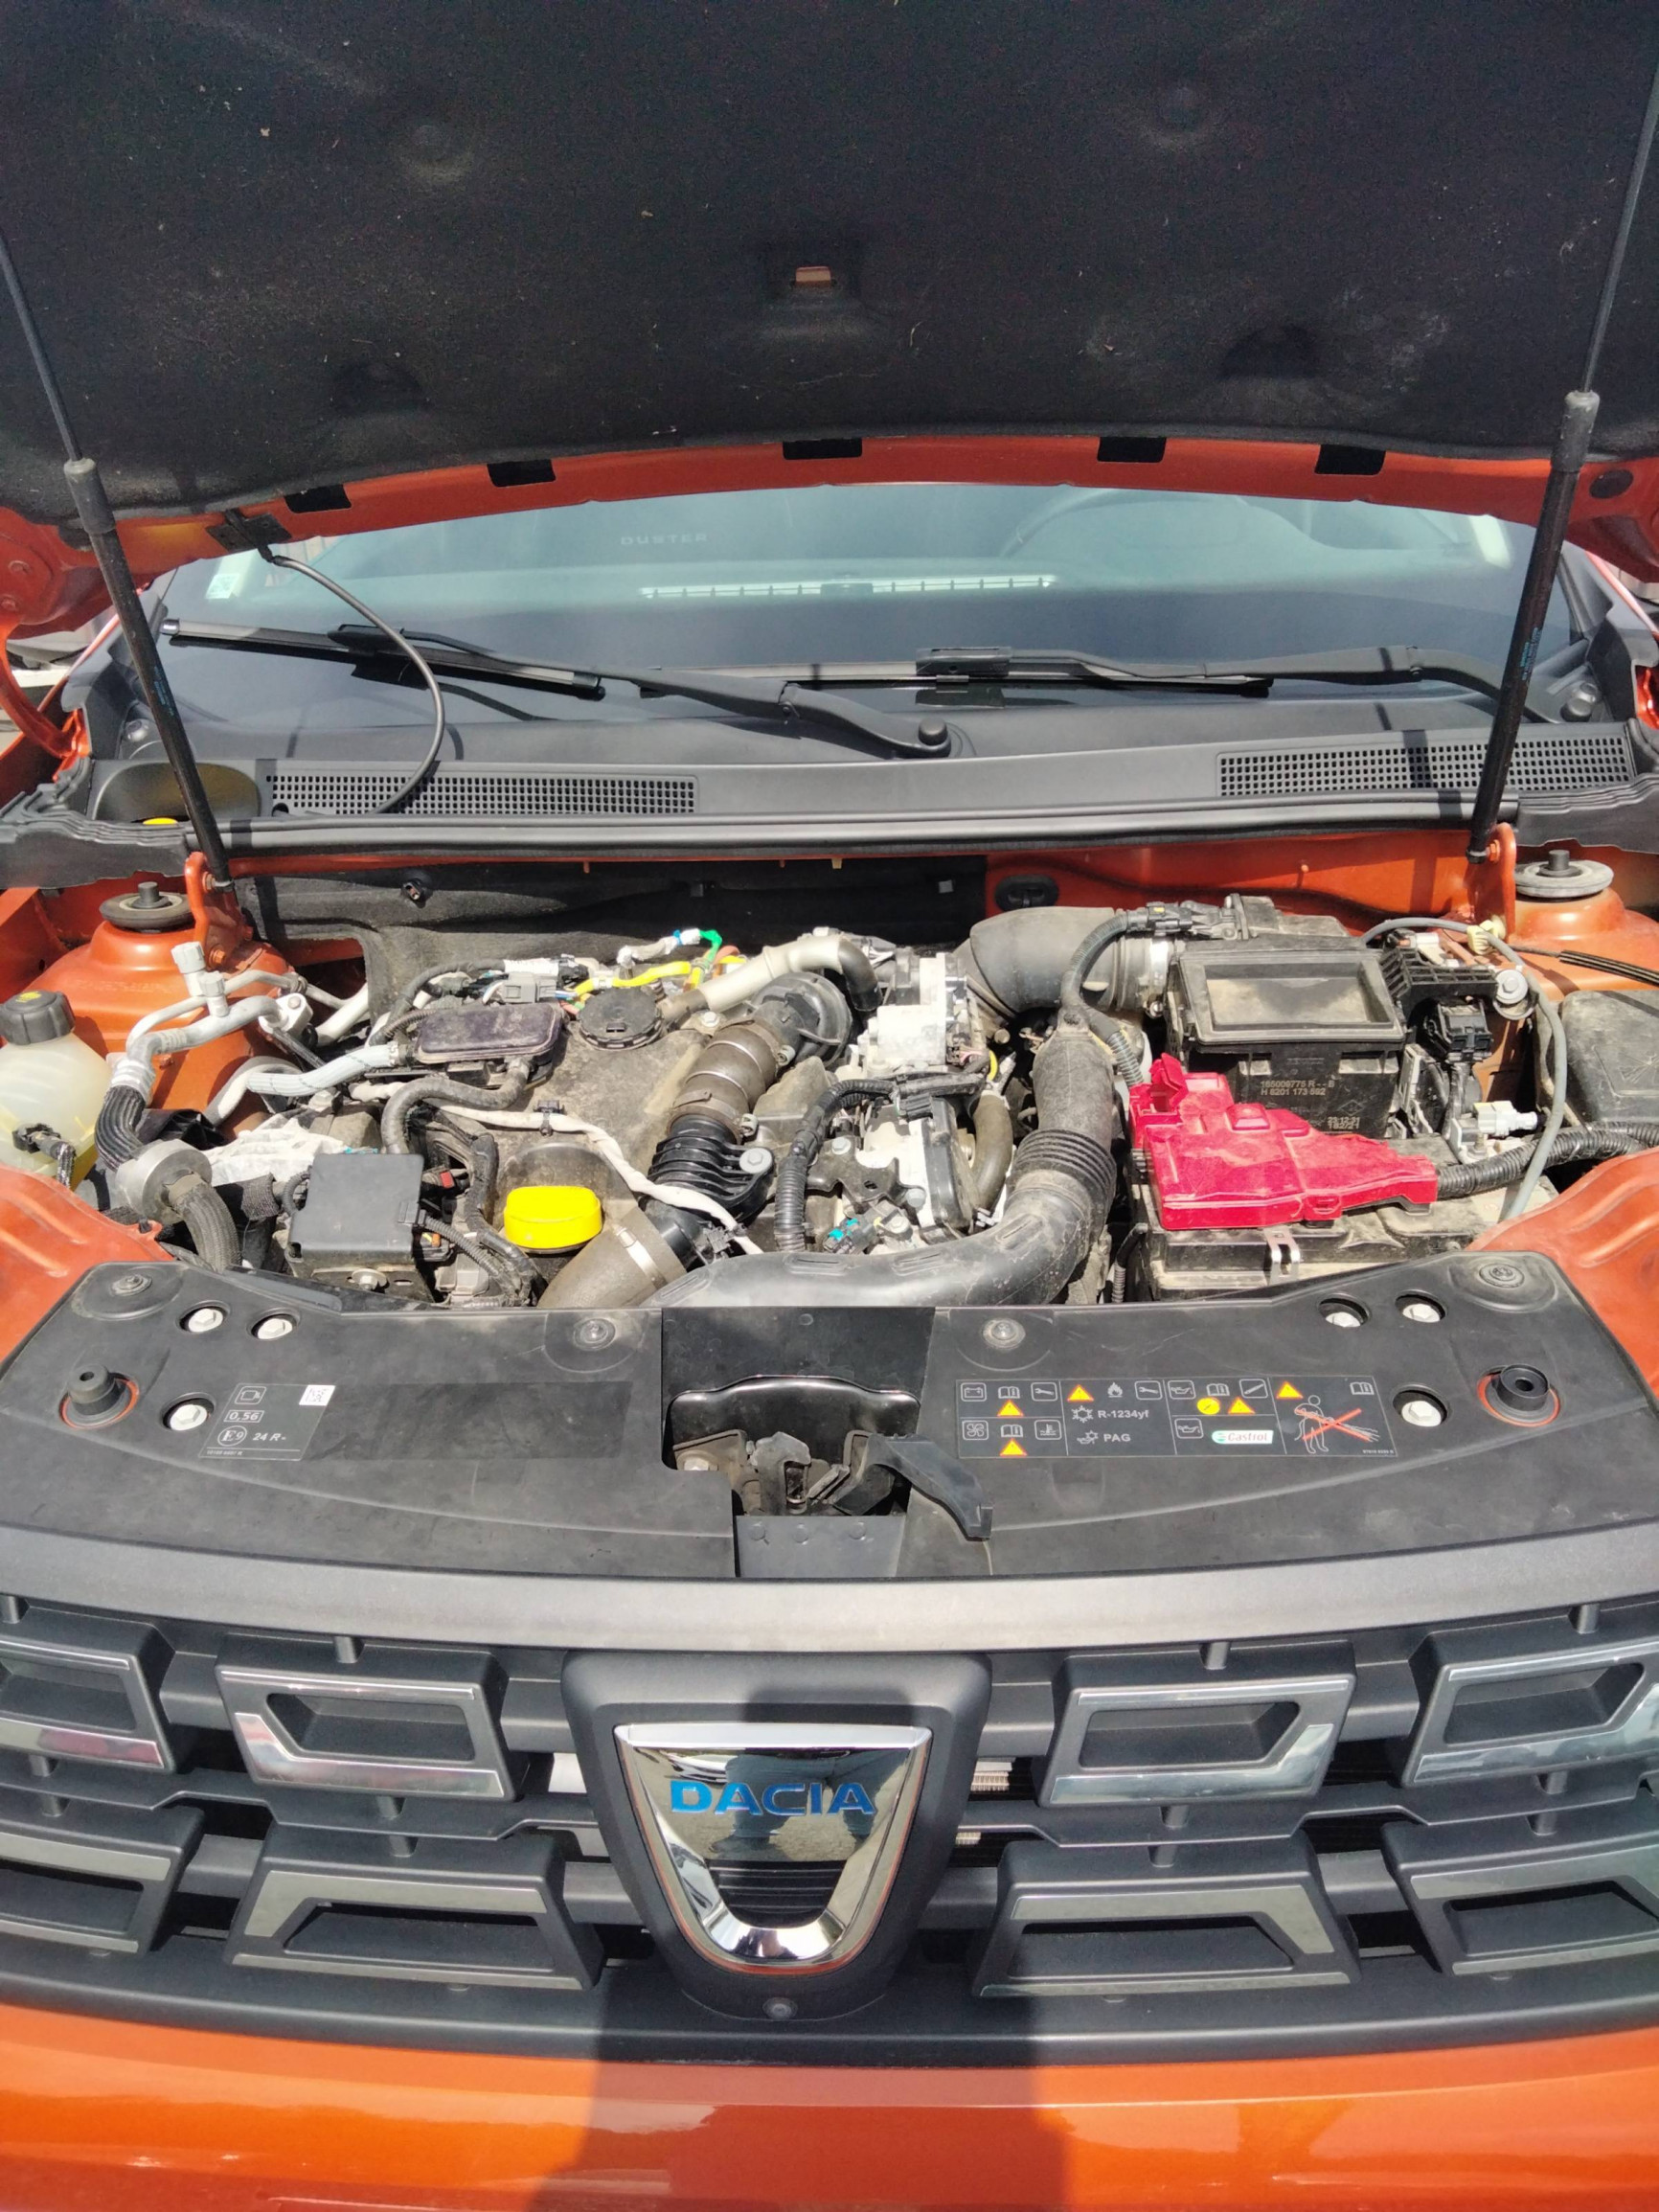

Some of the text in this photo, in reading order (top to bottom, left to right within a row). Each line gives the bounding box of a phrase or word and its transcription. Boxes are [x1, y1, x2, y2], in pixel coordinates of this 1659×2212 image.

[621, 533, 708, 545] DUSTER
[1098, 1410, 1149, 1420] R-1234yf
[252, 1432, 268, 1441] 24
[1103, 1433, 1131, 1442] PAG
[1227, 1432, 1267, 1442] Castrol
[670, 1780, 877, 1816] DACIA
